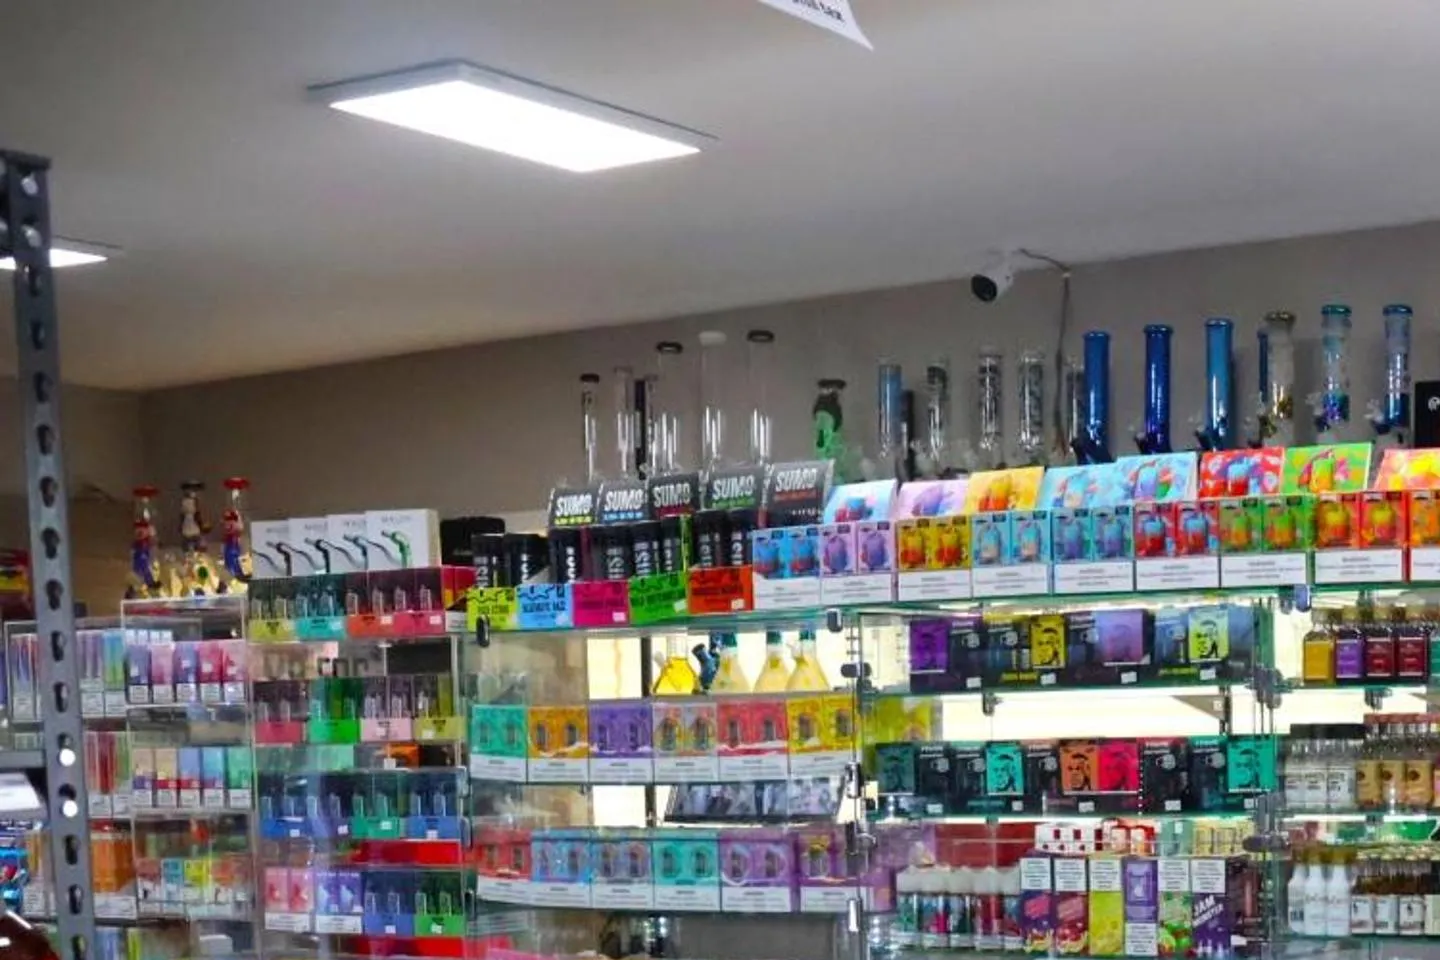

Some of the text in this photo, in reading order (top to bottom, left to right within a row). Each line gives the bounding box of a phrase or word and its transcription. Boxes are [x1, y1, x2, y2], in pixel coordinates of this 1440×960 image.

[713, 474, 755, 500] SUMO
[775, 468, 818, 492] SUMO
[556, 494, 593, 516] SUMO
[604, 488, 643, 511] SUMO
[652, 483, 691, 508] SUMO
